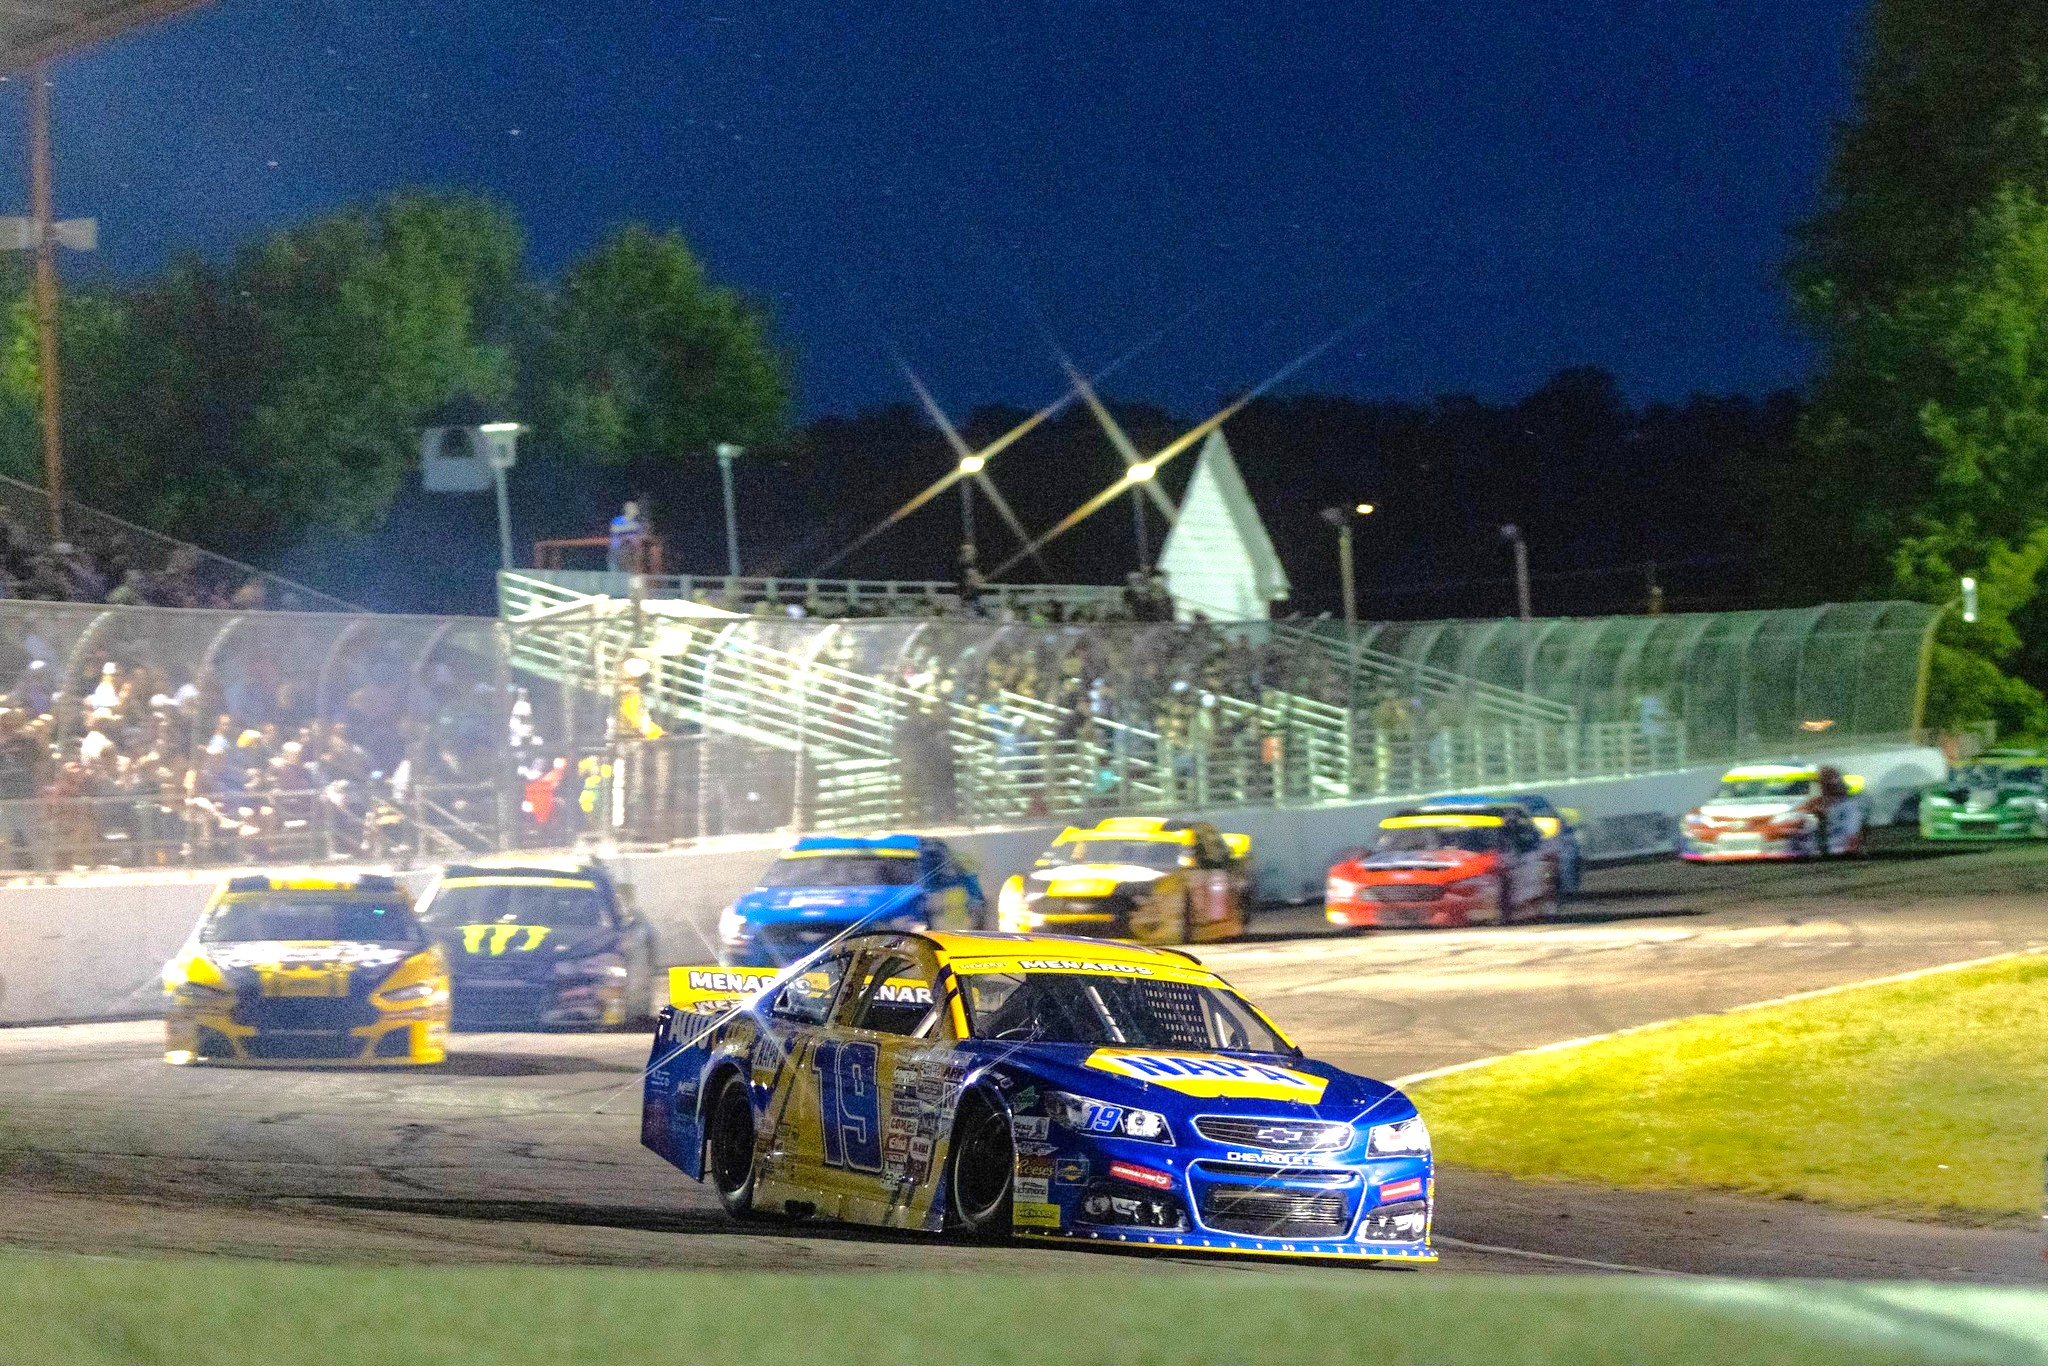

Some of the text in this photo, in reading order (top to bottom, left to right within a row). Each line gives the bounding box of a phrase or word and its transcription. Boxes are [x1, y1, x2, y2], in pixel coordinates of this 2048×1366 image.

[1018, 960, 1154, 975] MENARDS
[1117, 1056, 1307, 1086] NAPA
[812, 1038, 885, 1174] 19
[1082, 1105, 1124, 1132] 19
[1227, 1151, 1312, 1166] CHEVROLET
